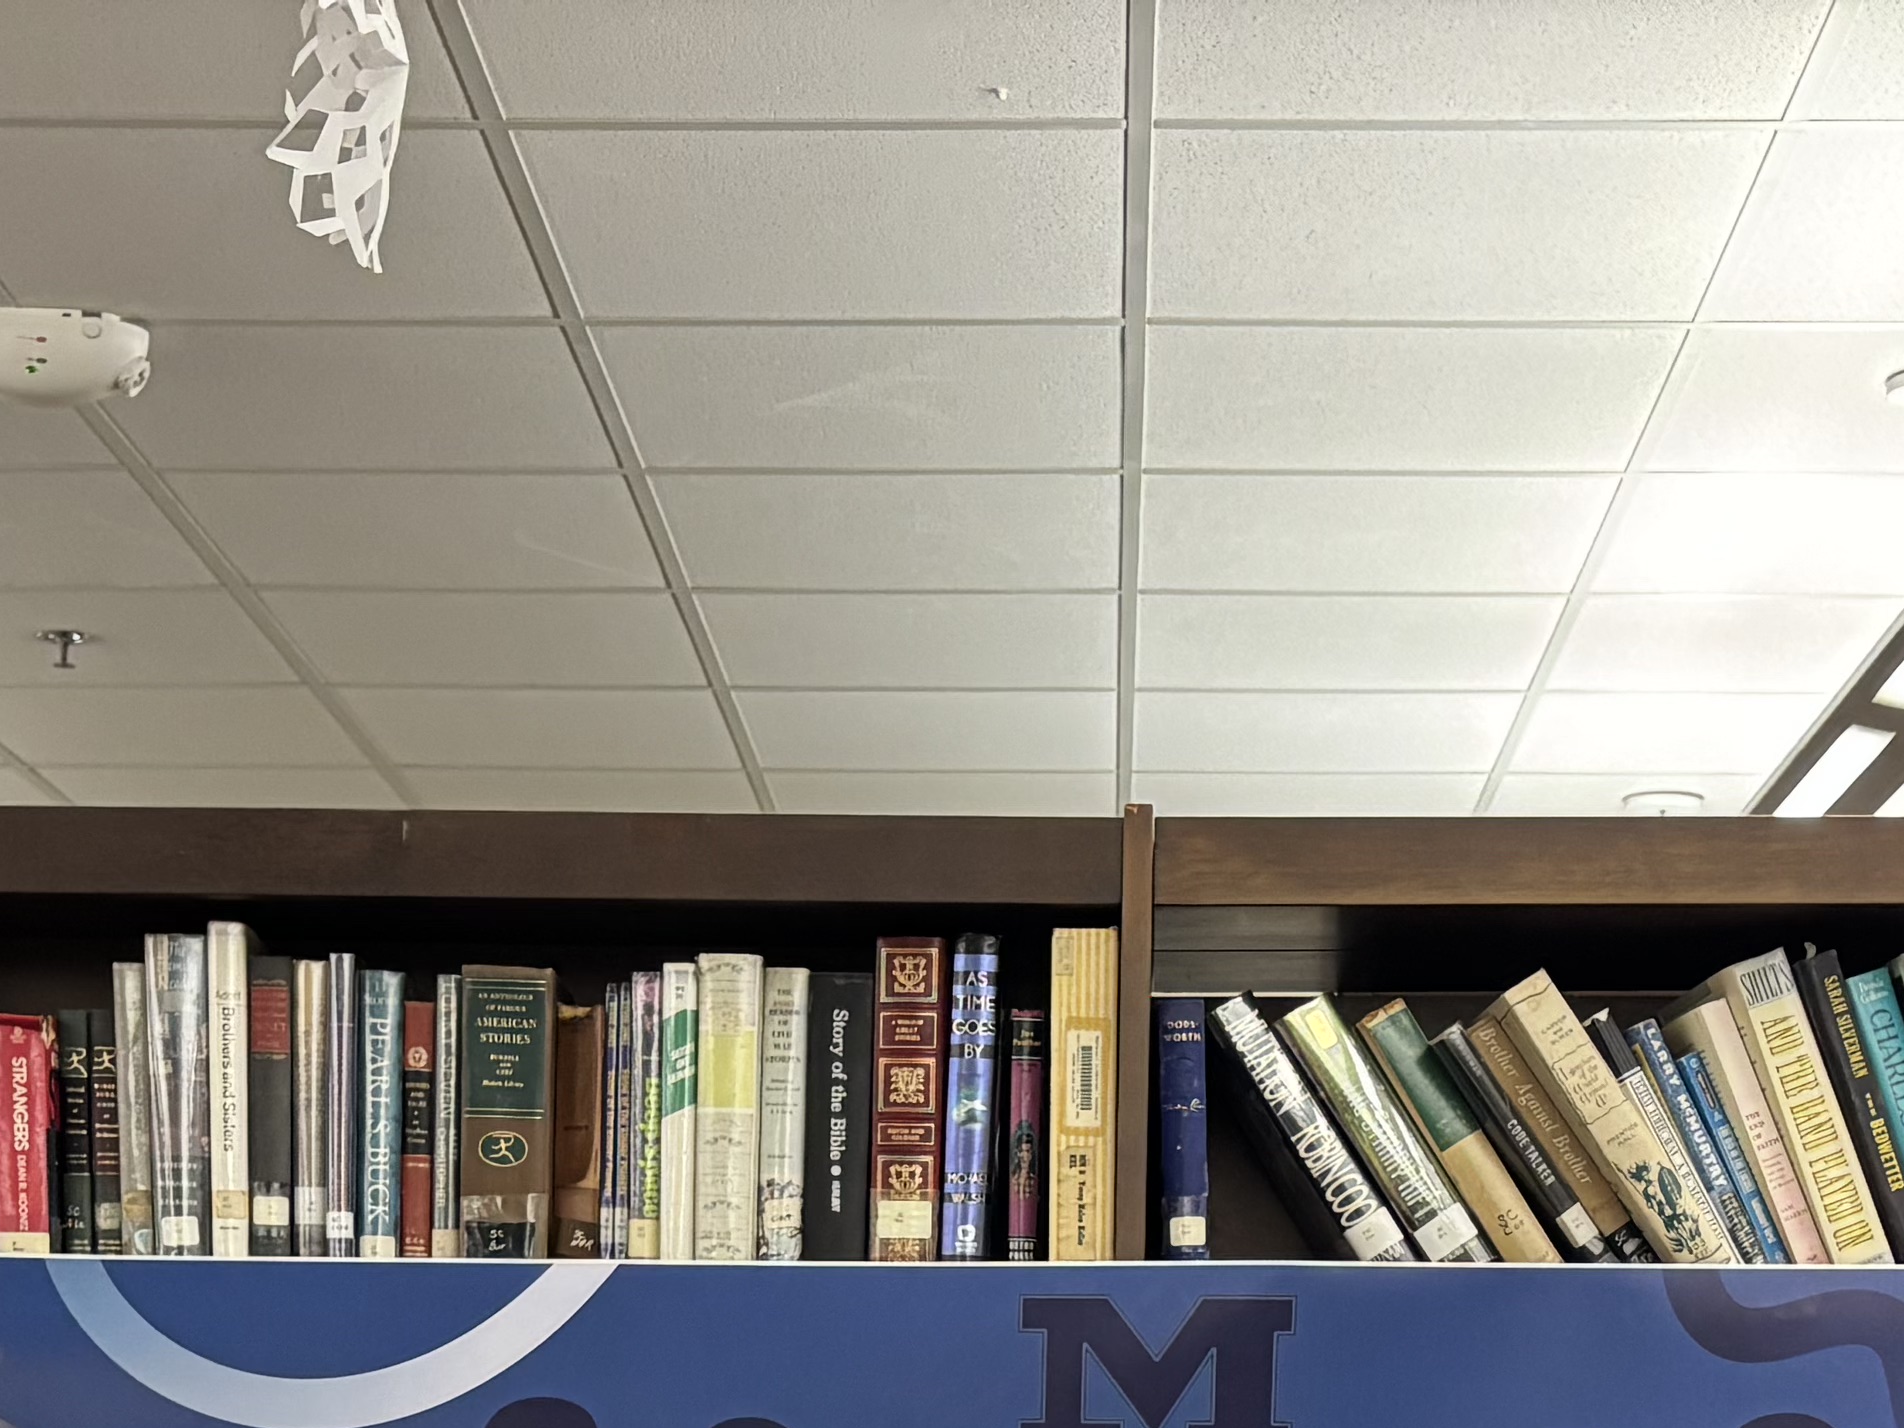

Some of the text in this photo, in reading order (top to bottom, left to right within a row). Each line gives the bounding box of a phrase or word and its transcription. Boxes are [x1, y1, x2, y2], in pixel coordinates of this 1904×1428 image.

[474, 1017, 537, 1029] AMERICAN
[952, 1019, 995, 1036] GOES
[956, 995, 995, 1012] TIME
[1824, 974, 1869, 1079] SARAH SILVERMAN
[480, 1033, 531, 1044] STORIES
[964, 1043, 984, 1059] BY
[1645, 1027, 1682, 1089] LARRY
[11, 1056, 29, 1151] STRANGERS
[222, 1007, 236, 1152] Brothers and Sisters
[829, 1008, 849, 1160] Story of the Bible
[1478, 1027, 1593, 1185] Brother Against Brother
[1522, 1146, 1556, 1187] TALKER
[1869, 1117, 1904, 1192] BEDWETTER
